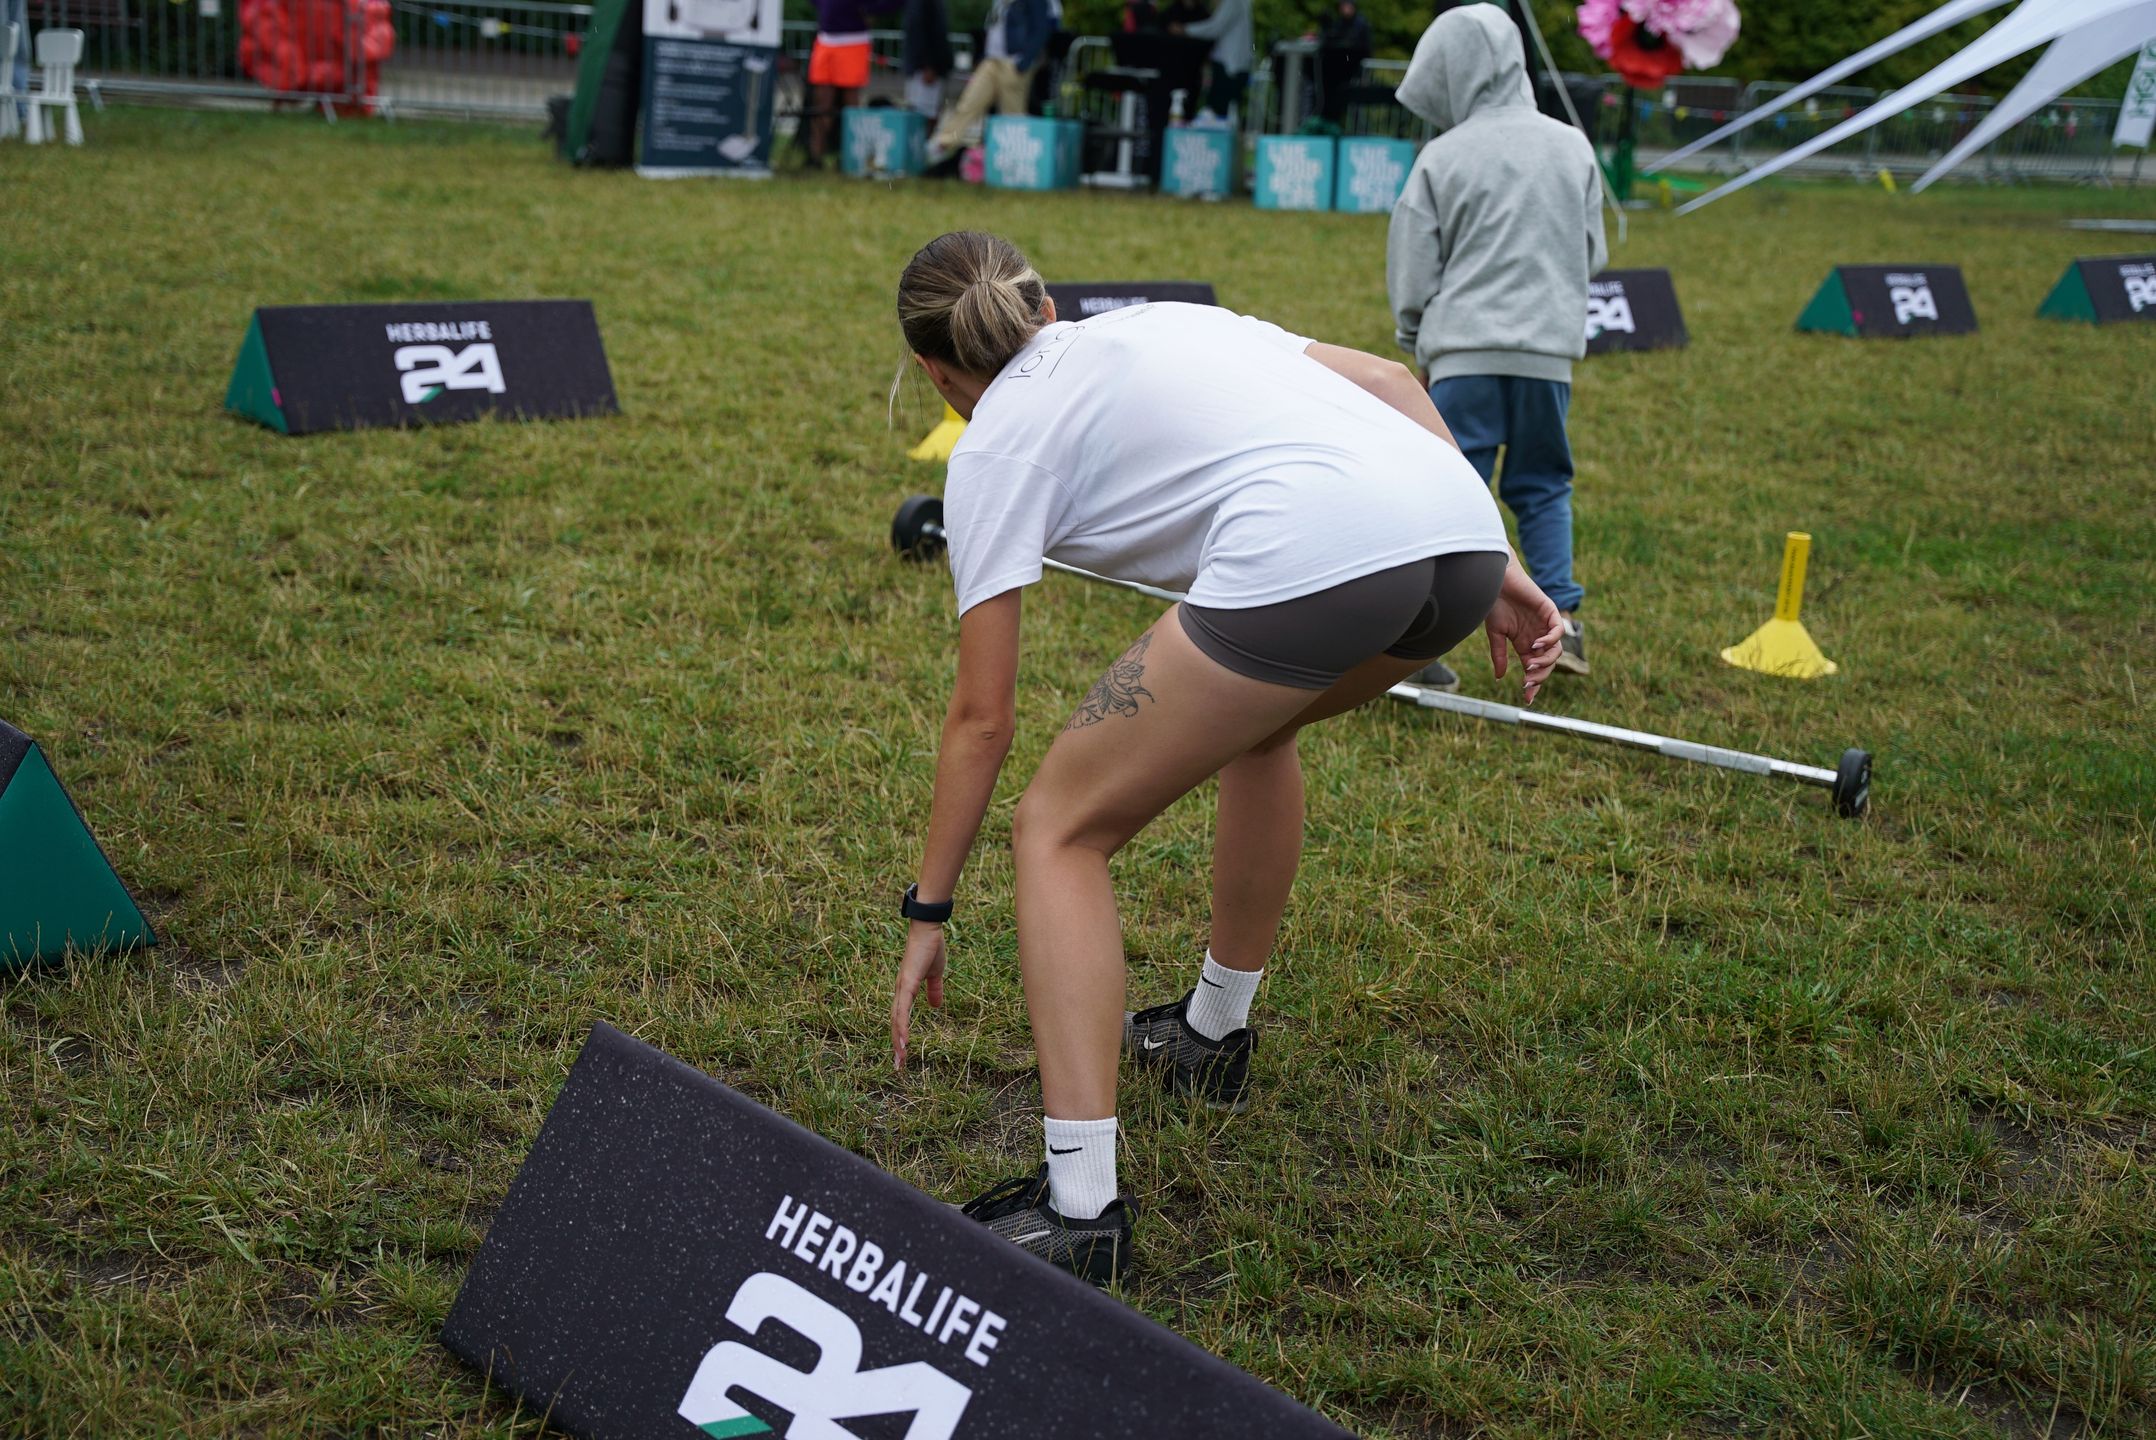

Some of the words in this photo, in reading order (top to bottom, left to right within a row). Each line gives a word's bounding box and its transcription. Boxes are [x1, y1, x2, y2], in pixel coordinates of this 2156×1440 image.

[385, 320, 493, 343] HERBALIFE
[394, 343, 507, 404] 24
[765, 1194, 1008, 1368] HERBALIFE
